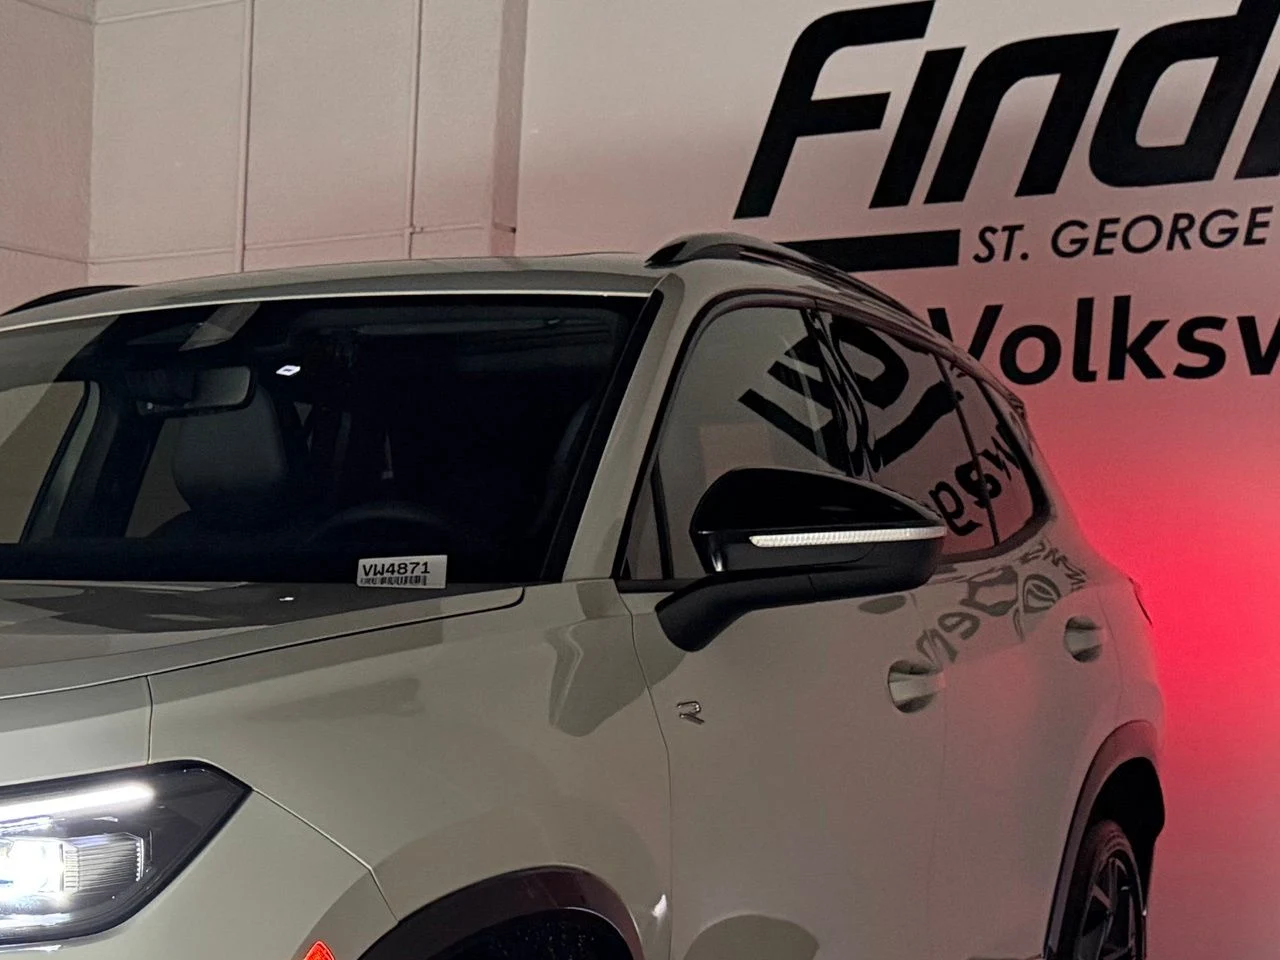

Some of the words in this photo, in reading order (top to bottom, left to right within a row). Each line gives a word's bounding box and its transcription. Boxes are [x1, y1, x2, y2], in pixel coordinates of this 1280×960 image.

[972, 224, 1030, 264] ST.
[1050, 206, 1274, 259] GEORGE
[362, 561, 431, 577] VW4871
